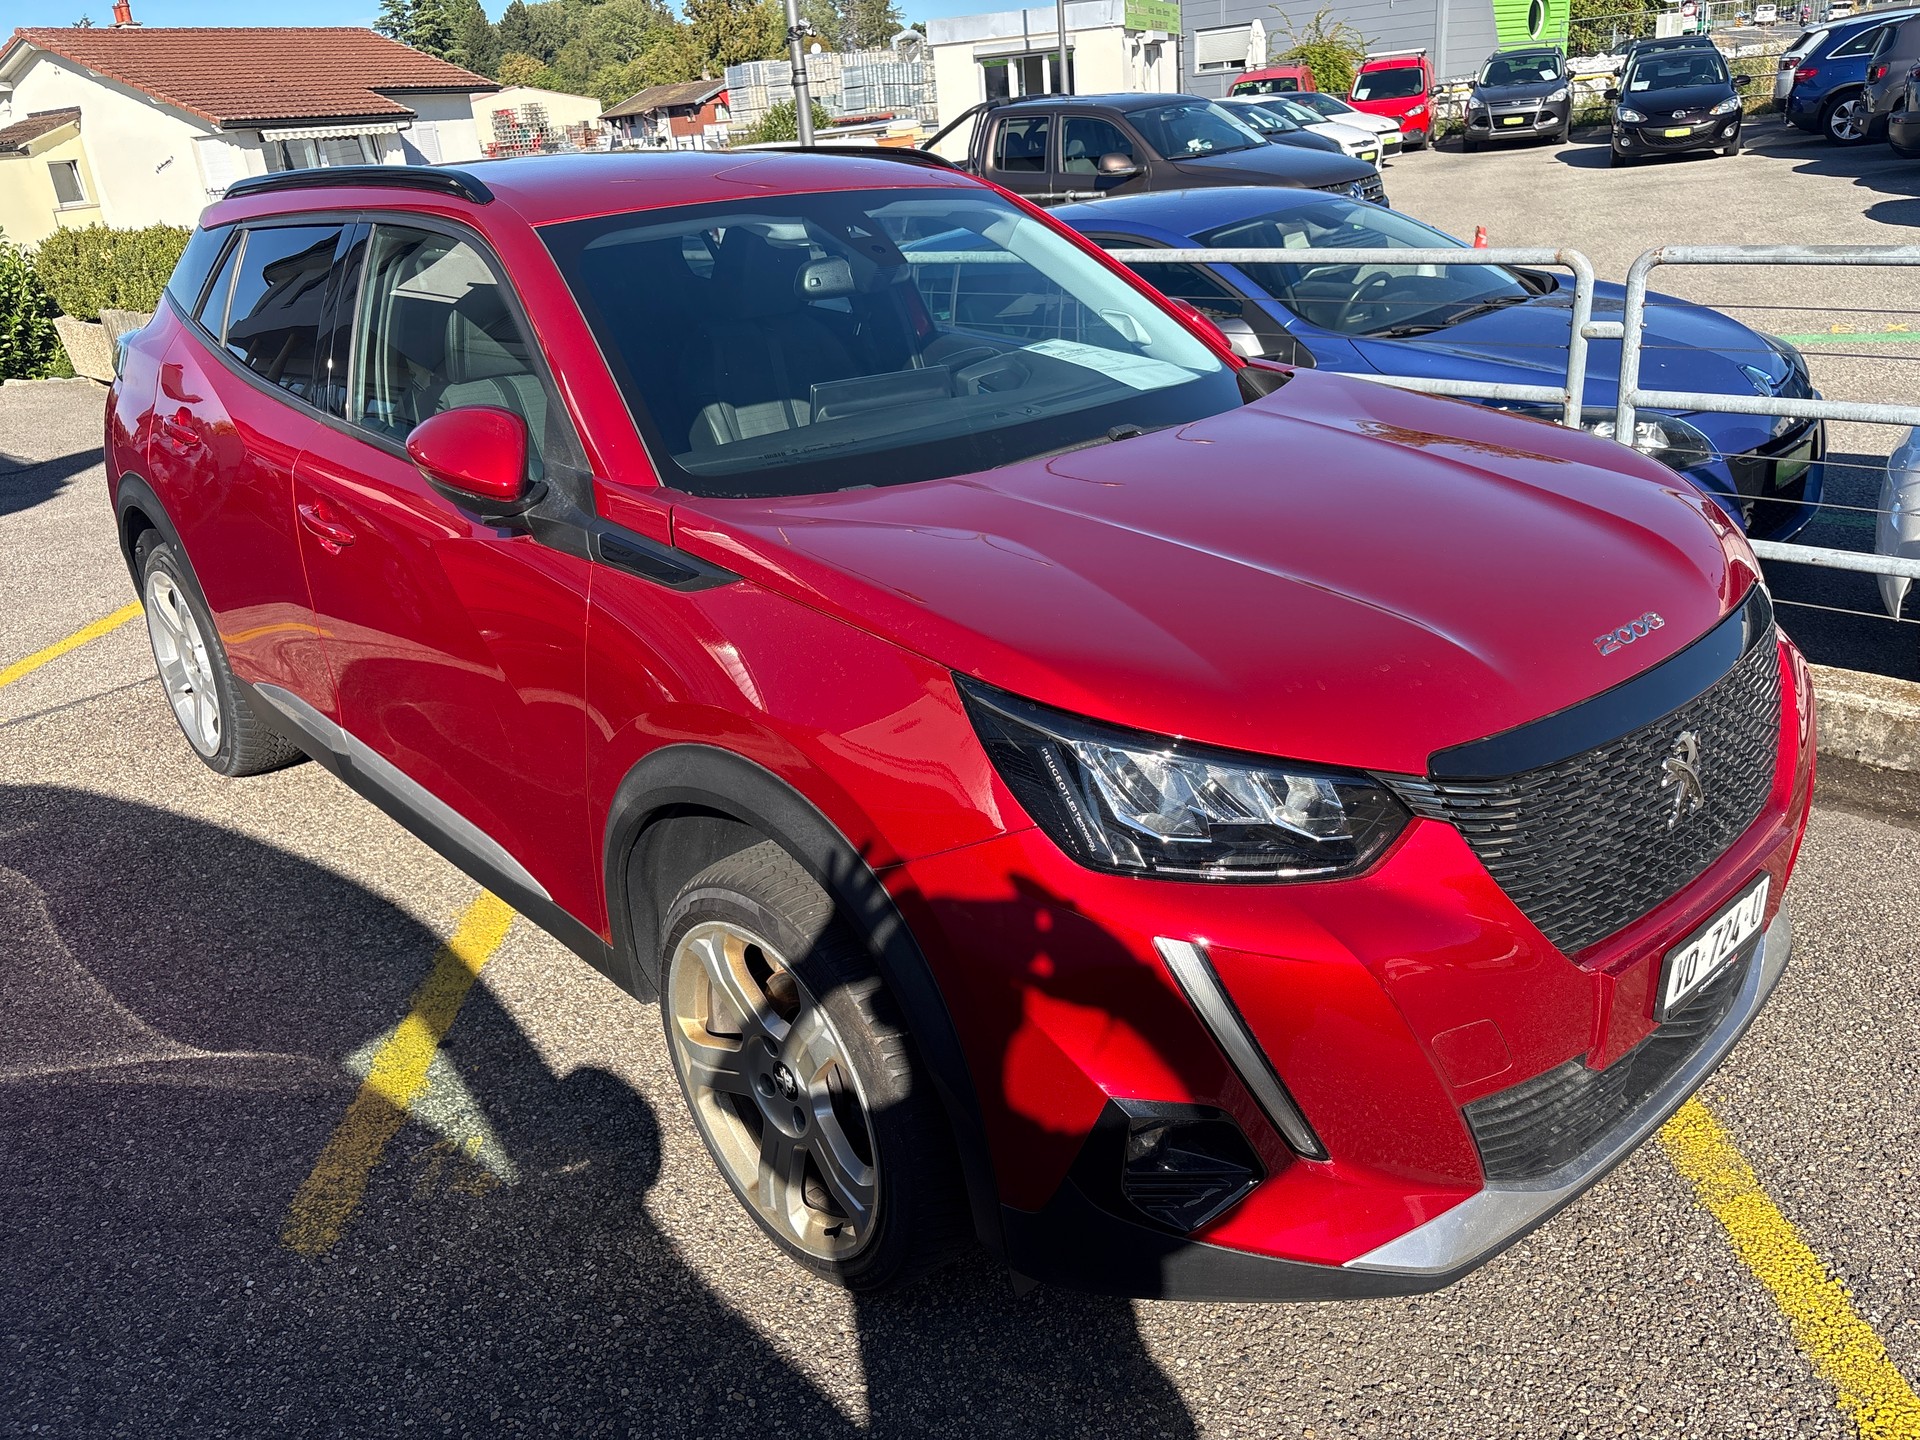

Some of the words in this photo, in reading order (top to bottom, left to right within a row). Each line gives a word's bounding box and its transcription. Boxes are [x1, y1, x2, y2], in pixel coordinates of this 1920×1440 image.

[1593, 611, 1665, 656] 2008
[1041, 748, 1070, 797] PEUGEOT
[1066, 796, 1078, 812] LED
[1074, 812, 1097, 852] Technology
